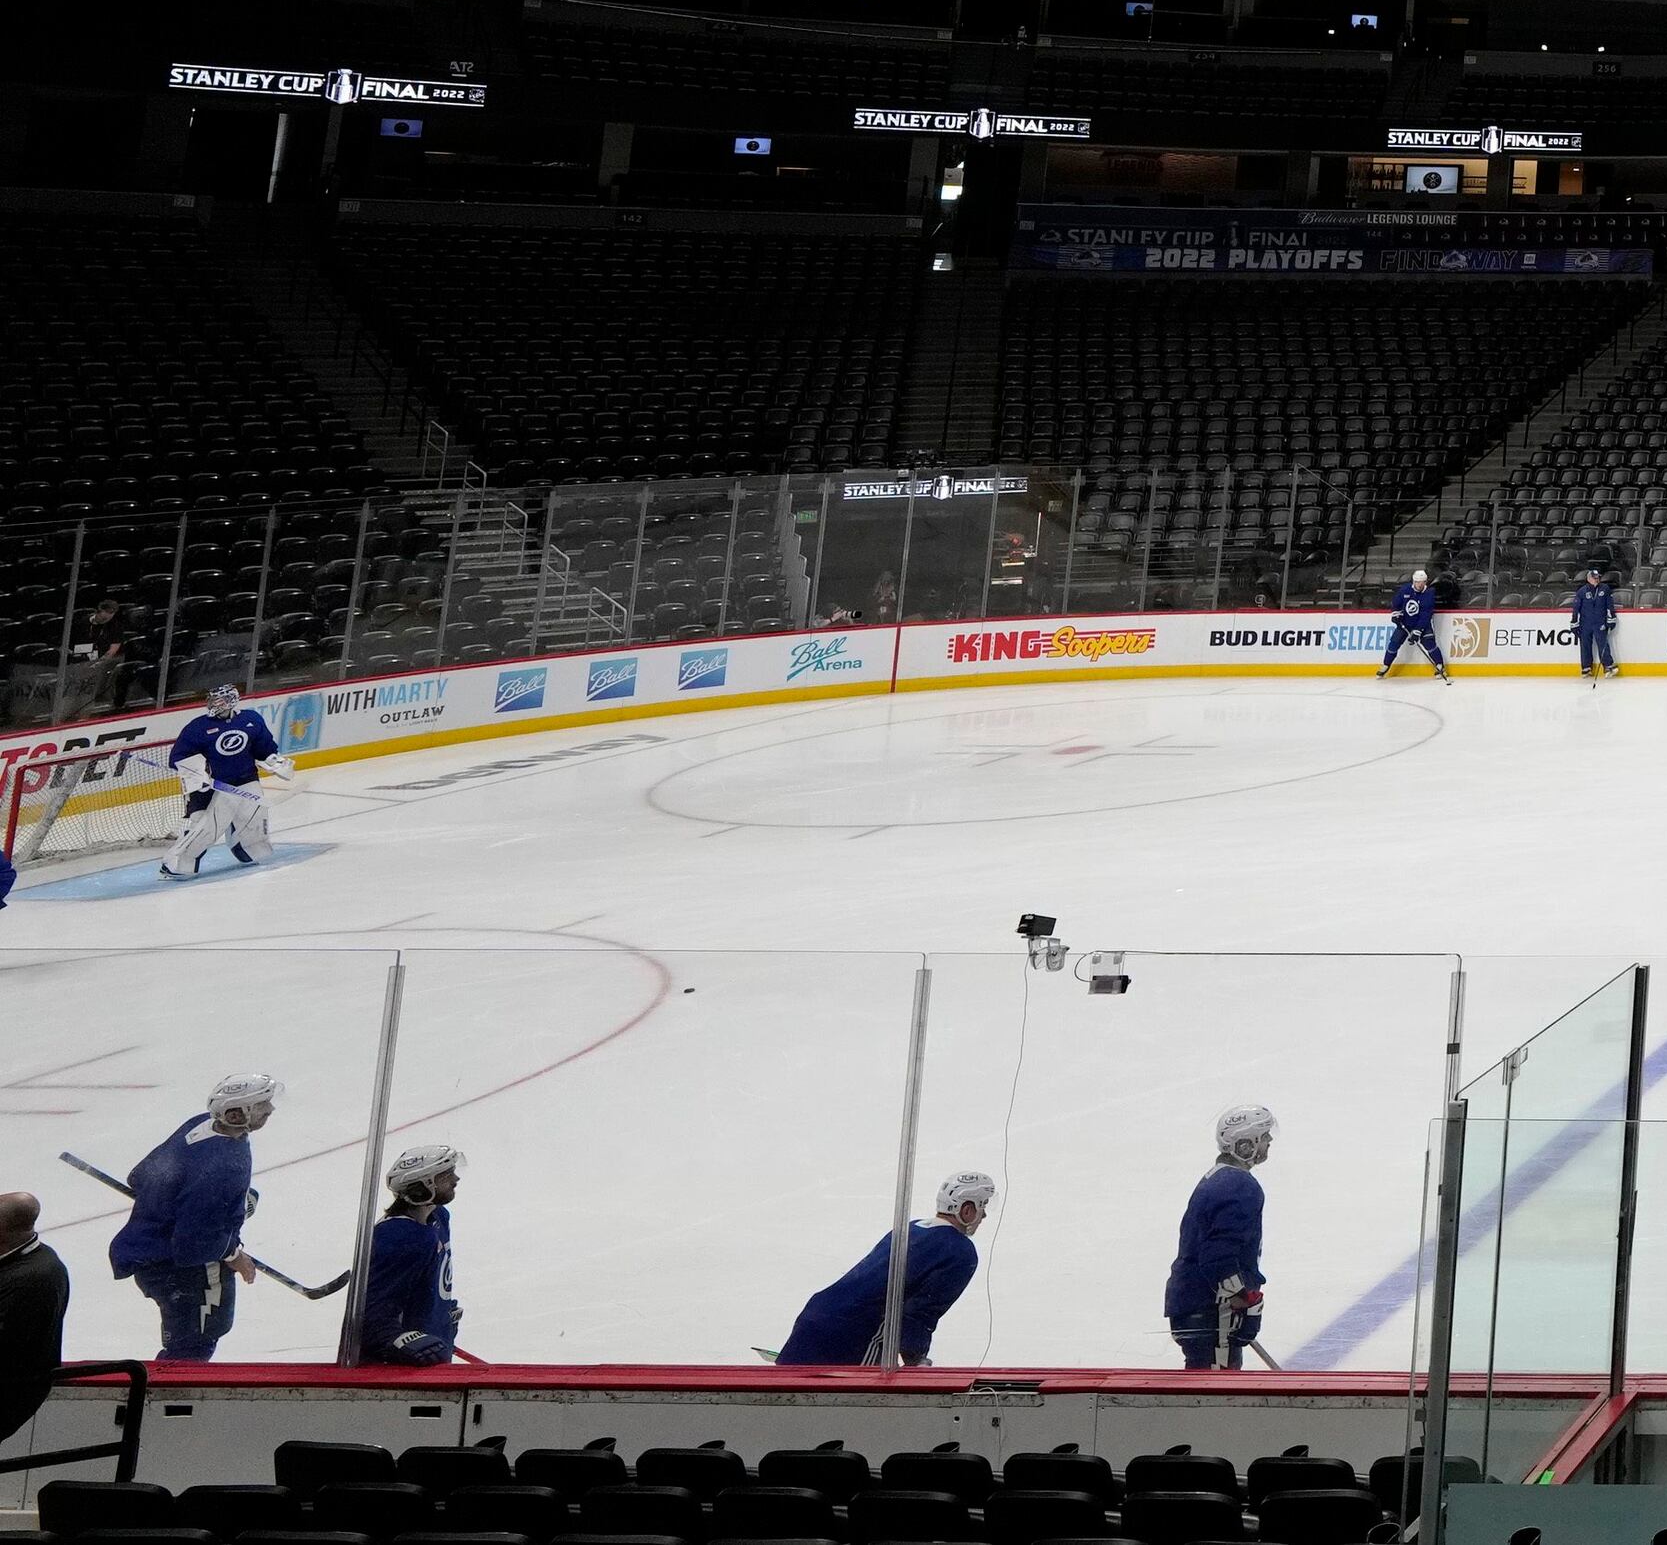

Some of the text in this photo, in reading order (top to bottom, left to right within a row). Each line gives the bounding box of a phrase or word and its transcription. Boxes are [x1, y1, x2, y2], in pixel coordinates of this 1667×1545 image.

[170, 68, 465, 99] STANLEY CUP FINAL 2022
[854, 112, 1074, 132] STANLEY CUP FINAL 2022
[1388, 132, 1451, 146] STANLEY
[1452, 133, 1480, 146] CUP
[1503, 135, 1546, 147] FINAL
[1367, 214, 1457, 225] LEGENDS LOUNGE
[1144, 248, 1364, 271] 2022 PLAYOFFS
[844, 483, 903, 496] STANLEY
[953, 625, 1152, 663] KING Soopers
[1209, 630, 1326, 647] BUD LIGHT
[791, 636, 847, 668] Ball
[680, 649, 727, 681] Ball
[814, 656, 862, 673] Arena
[499, 670, 547, 702] Ball
[589, 659, 637, 692] Ball
[379, 705, 445, 725] OUTLAW
